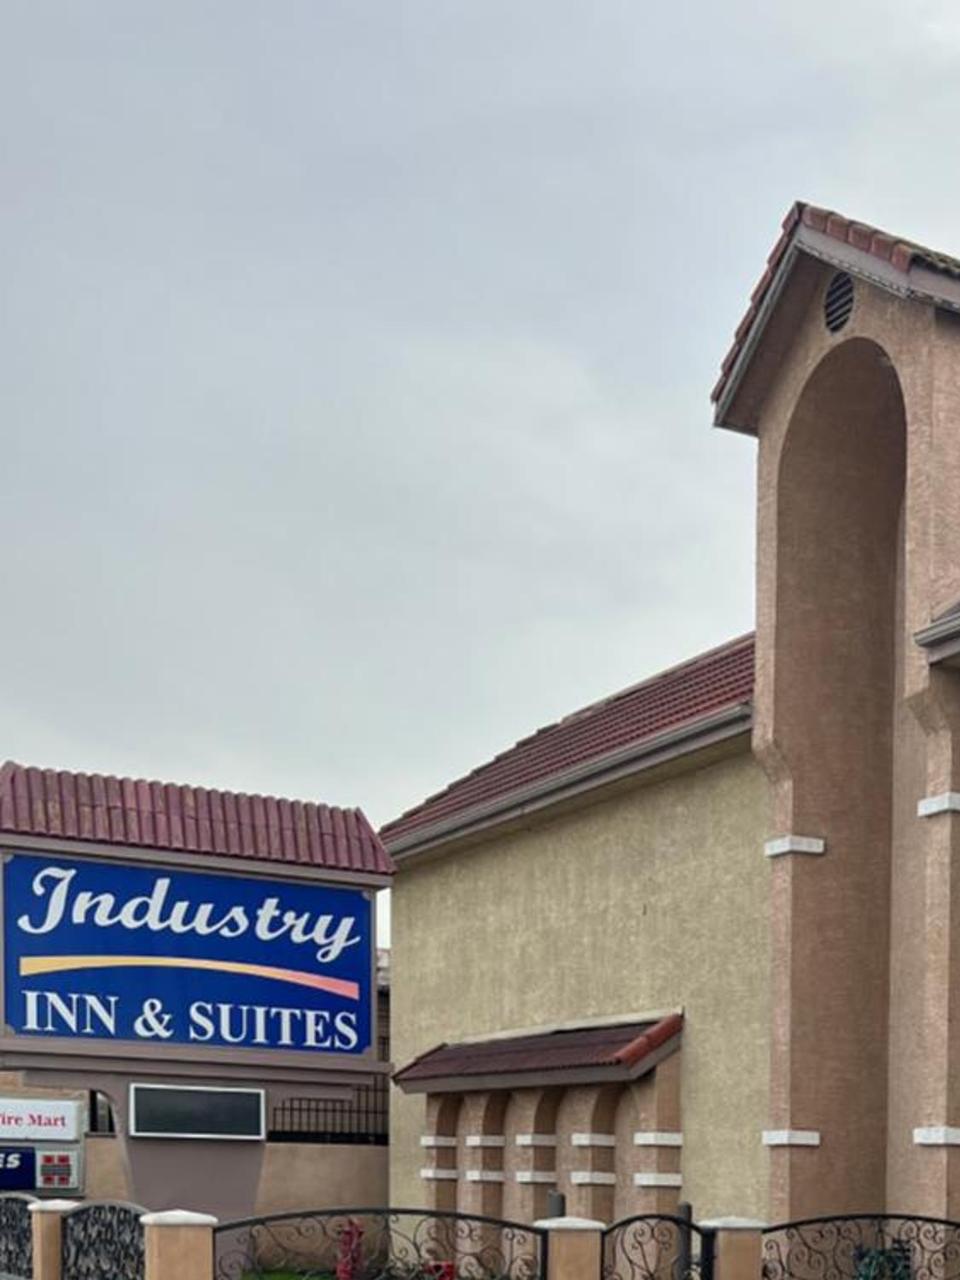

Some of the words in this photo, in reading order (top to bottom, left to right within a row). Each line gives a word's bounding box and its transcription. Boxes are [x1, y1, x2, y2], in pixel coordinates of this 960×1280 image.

[17, 866, 361, 963] Industry
[22, 990, 120, 1036] INN
[133, 998, 174, 1039] &
[188, 1001, 359, 1051] SUITES
[0, 1112, 23, 1127] ire
[28, 1113, 66, 1128] Mart
